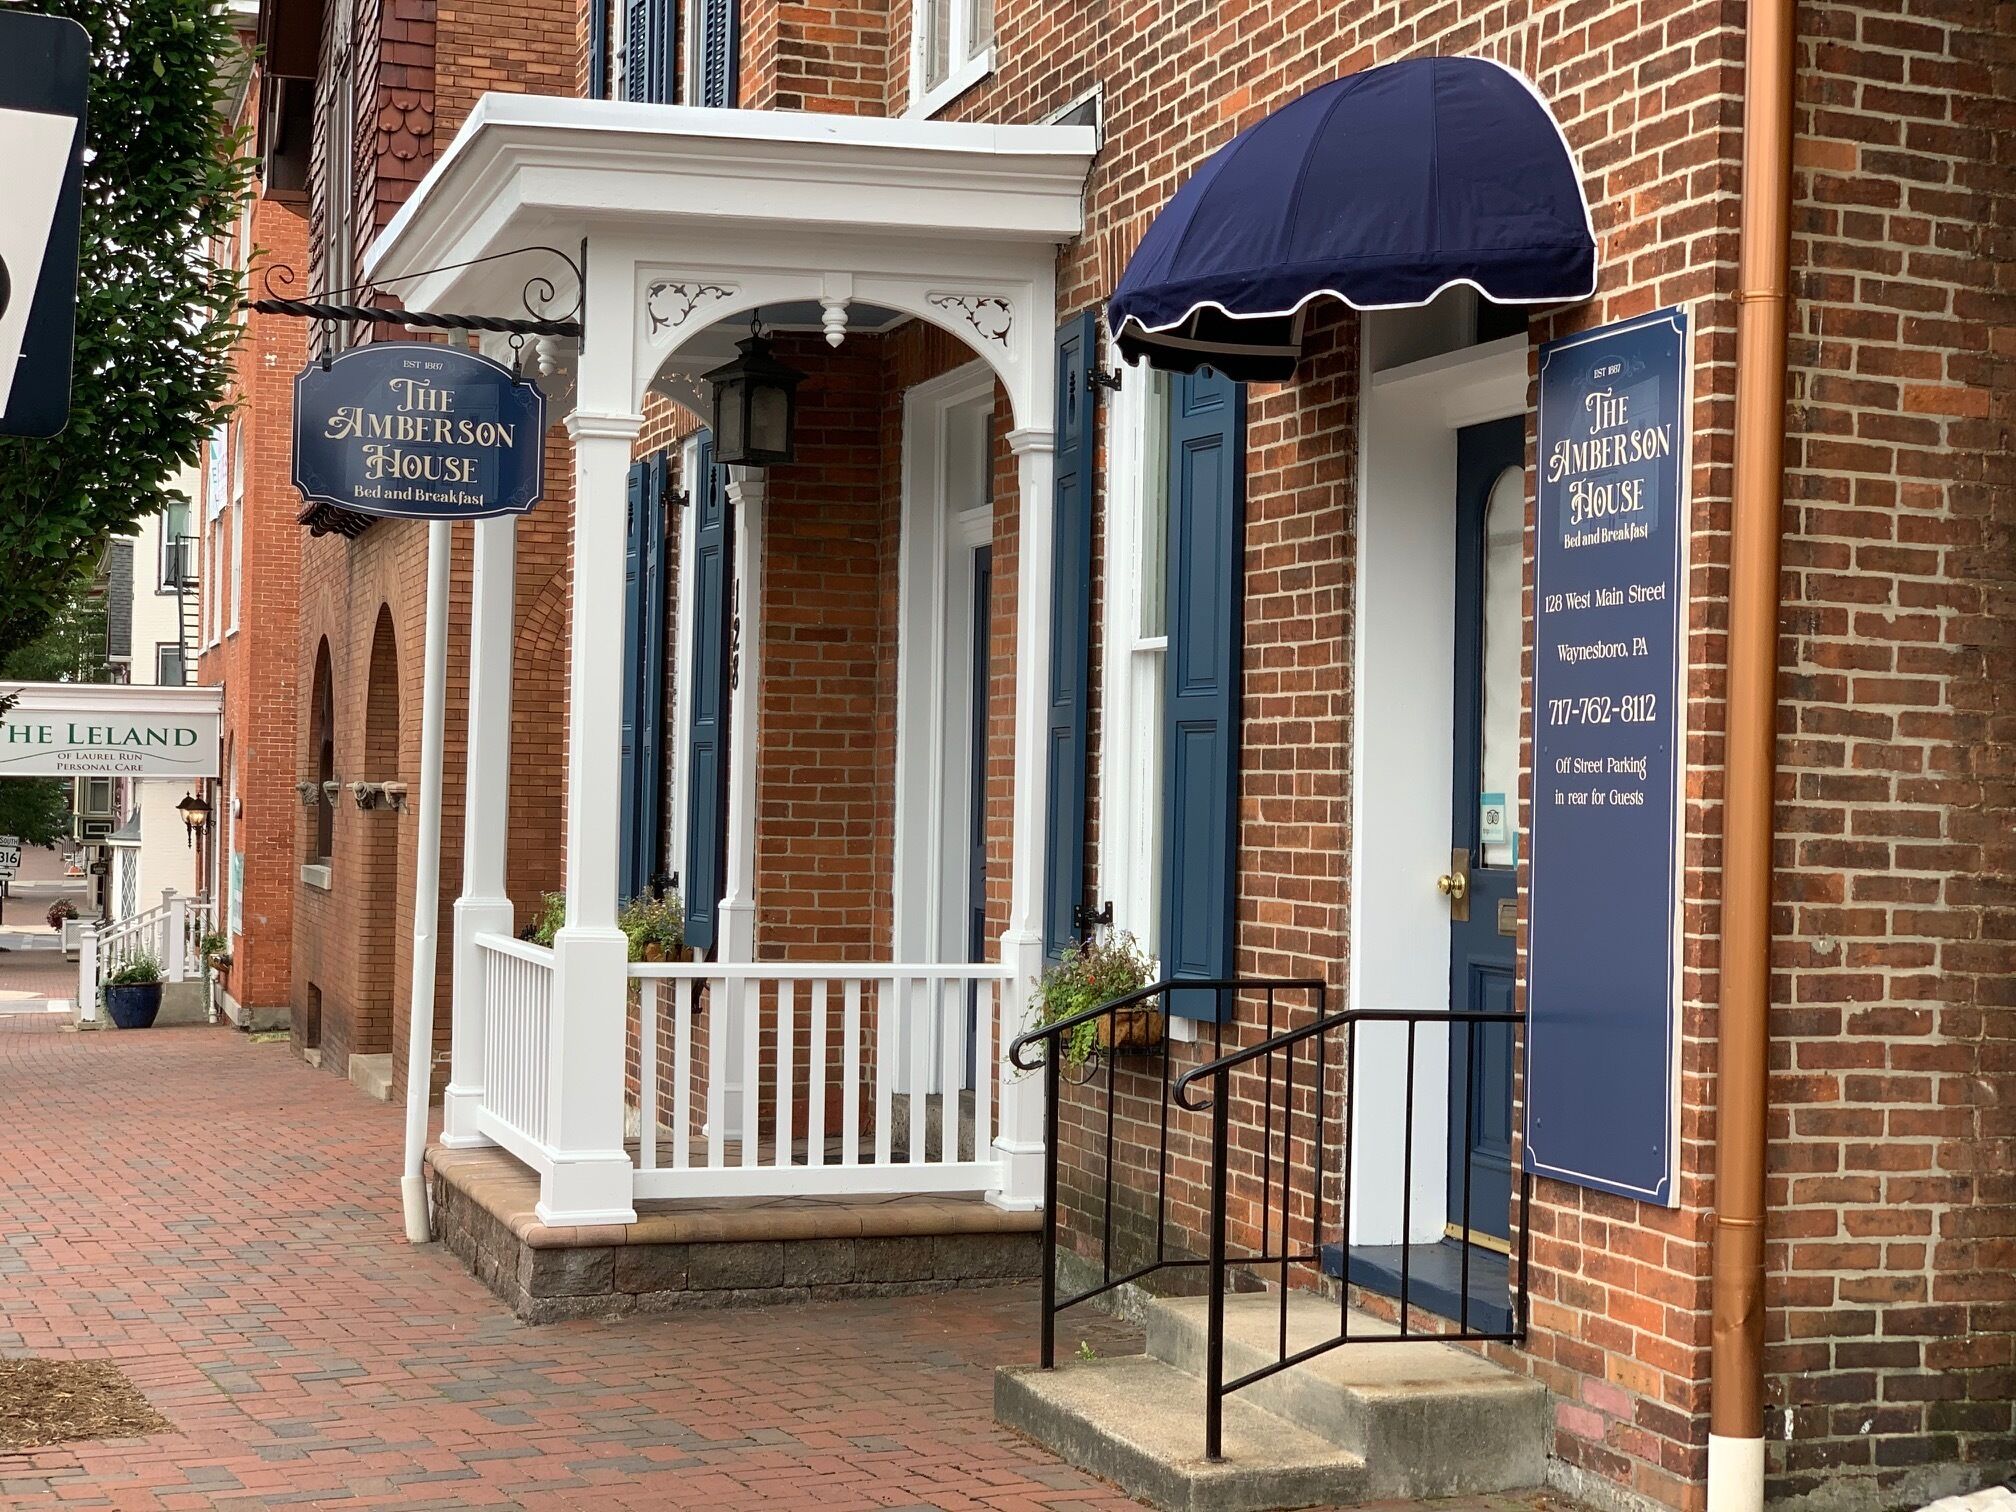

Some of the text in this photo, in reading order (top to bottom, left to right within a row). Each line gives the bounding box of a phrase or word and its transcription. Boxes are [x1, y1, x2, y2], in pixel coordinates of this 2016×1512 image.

[403, 360, 421, 369] EST
[1593, 367, 1606, 379] EST
[389, 378, 456, 413] THE
[1585, 387, 1629, 435] THE
[324, 406, 516, 448] AMBERSON
[362, 443, 479, 483] HOUSE
[1547, 423, 1672, 483] AMBERSON
[354, 484, 484, 507] Bed and Breakfast
[1569, 478, 1645, 525] HOUSE
[1564, 522, 1649, 549] Bed and Breakfast
[1545, 581, 1666, 613] 128 West Main Street
[1557, 637, 1649, 664] Waynesboro, PA
[1549, 694, 1657, 726] 717-762-8112
[8, 723, 199, 747] HE LELAND
[56, 762, 144, 772] PERSONAL CARE
[57, 752, 143, 762] OF LAUREL RUN
[1555, 755, 1648, 781] Off Street Parking
[1555, 788, 1645, 806] in rear for Guests
